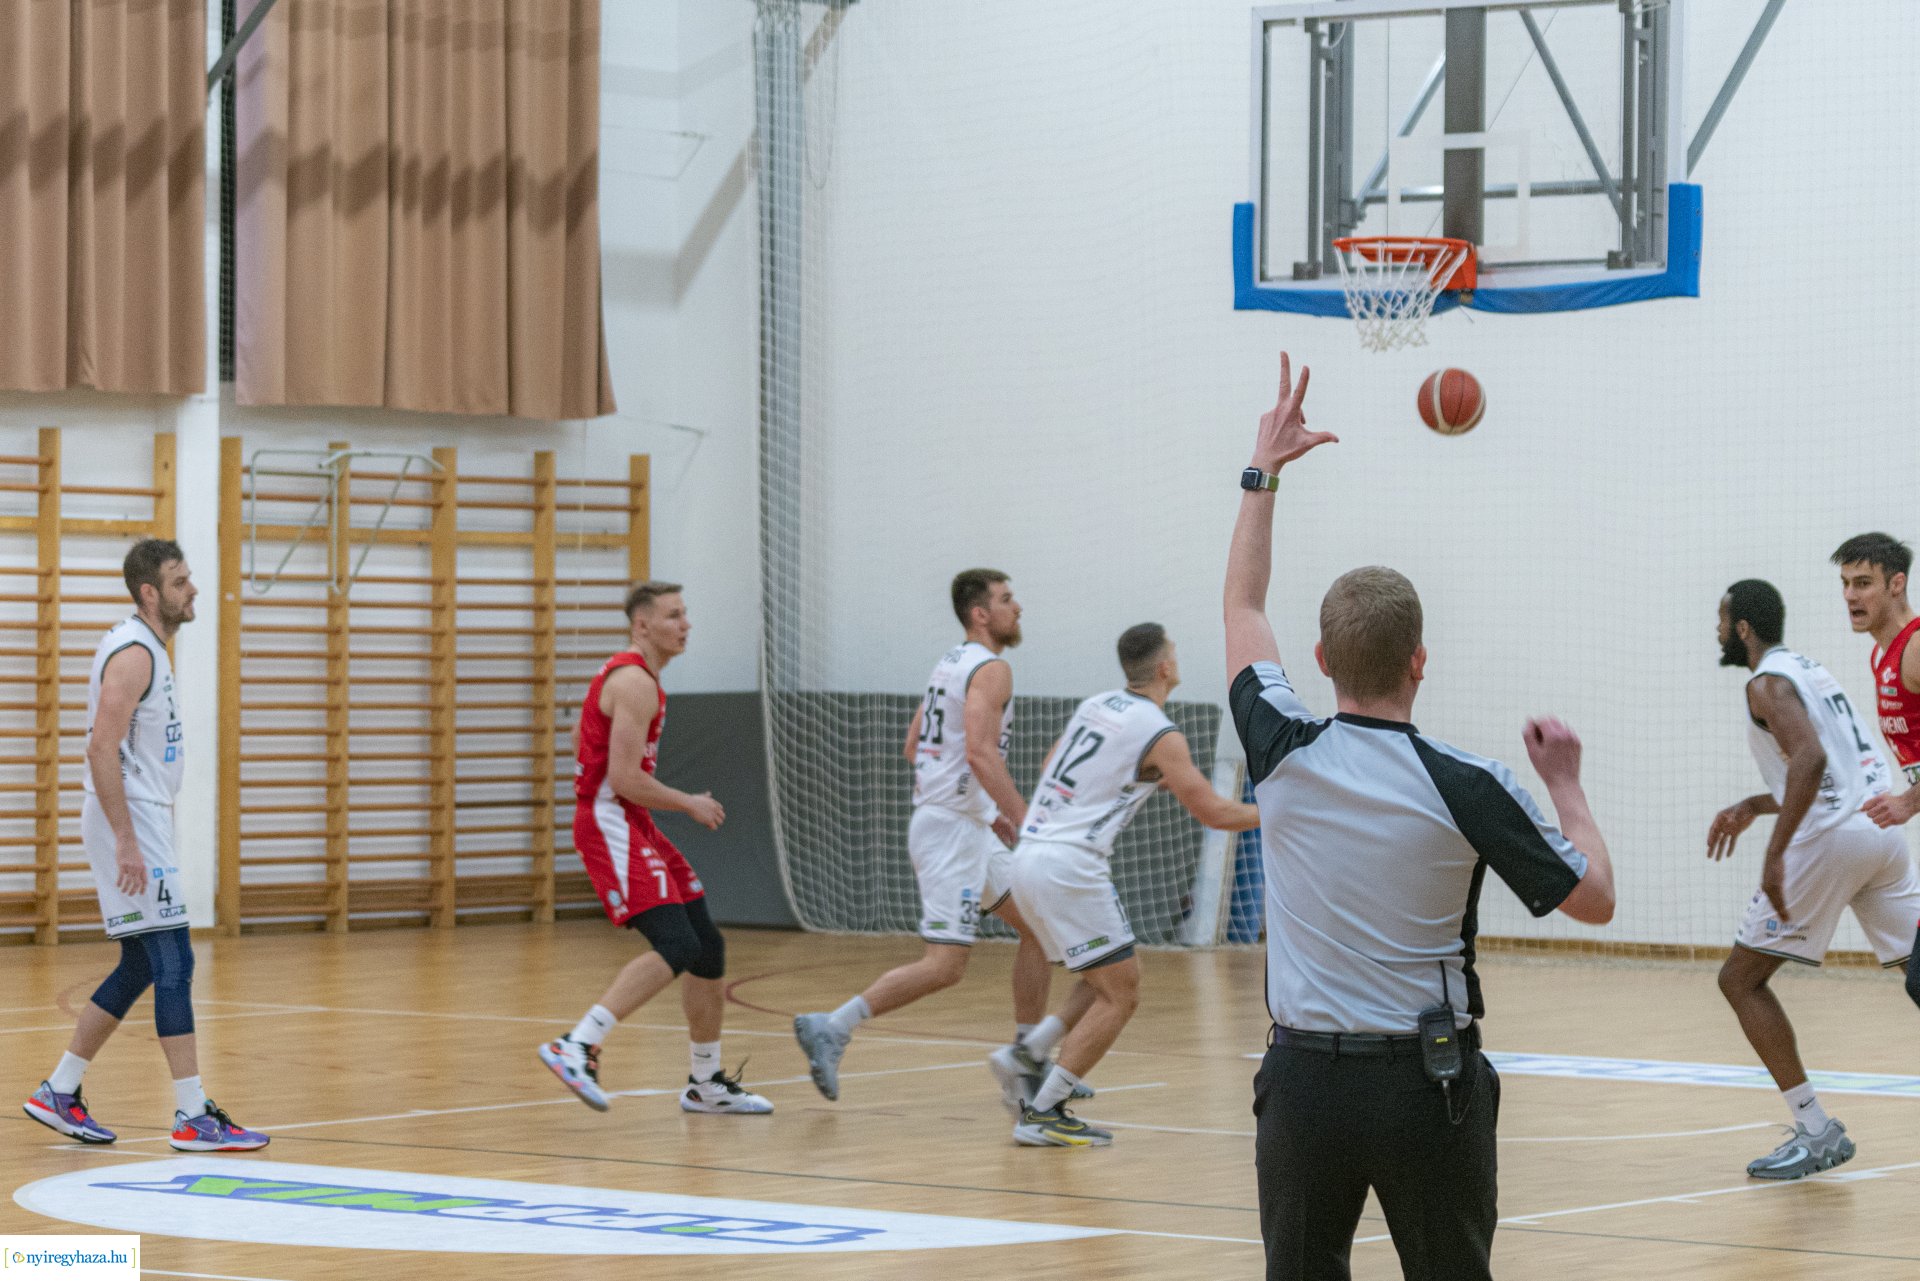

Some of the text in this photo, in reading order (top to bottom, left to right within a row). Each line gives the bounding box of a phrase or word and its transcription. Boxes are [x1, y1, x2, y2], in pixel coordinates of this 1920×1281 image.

[1052, 725, 1104, 788] 12
[157, 879, 173, 905] 4
[651, 870, 669, 898] 7
